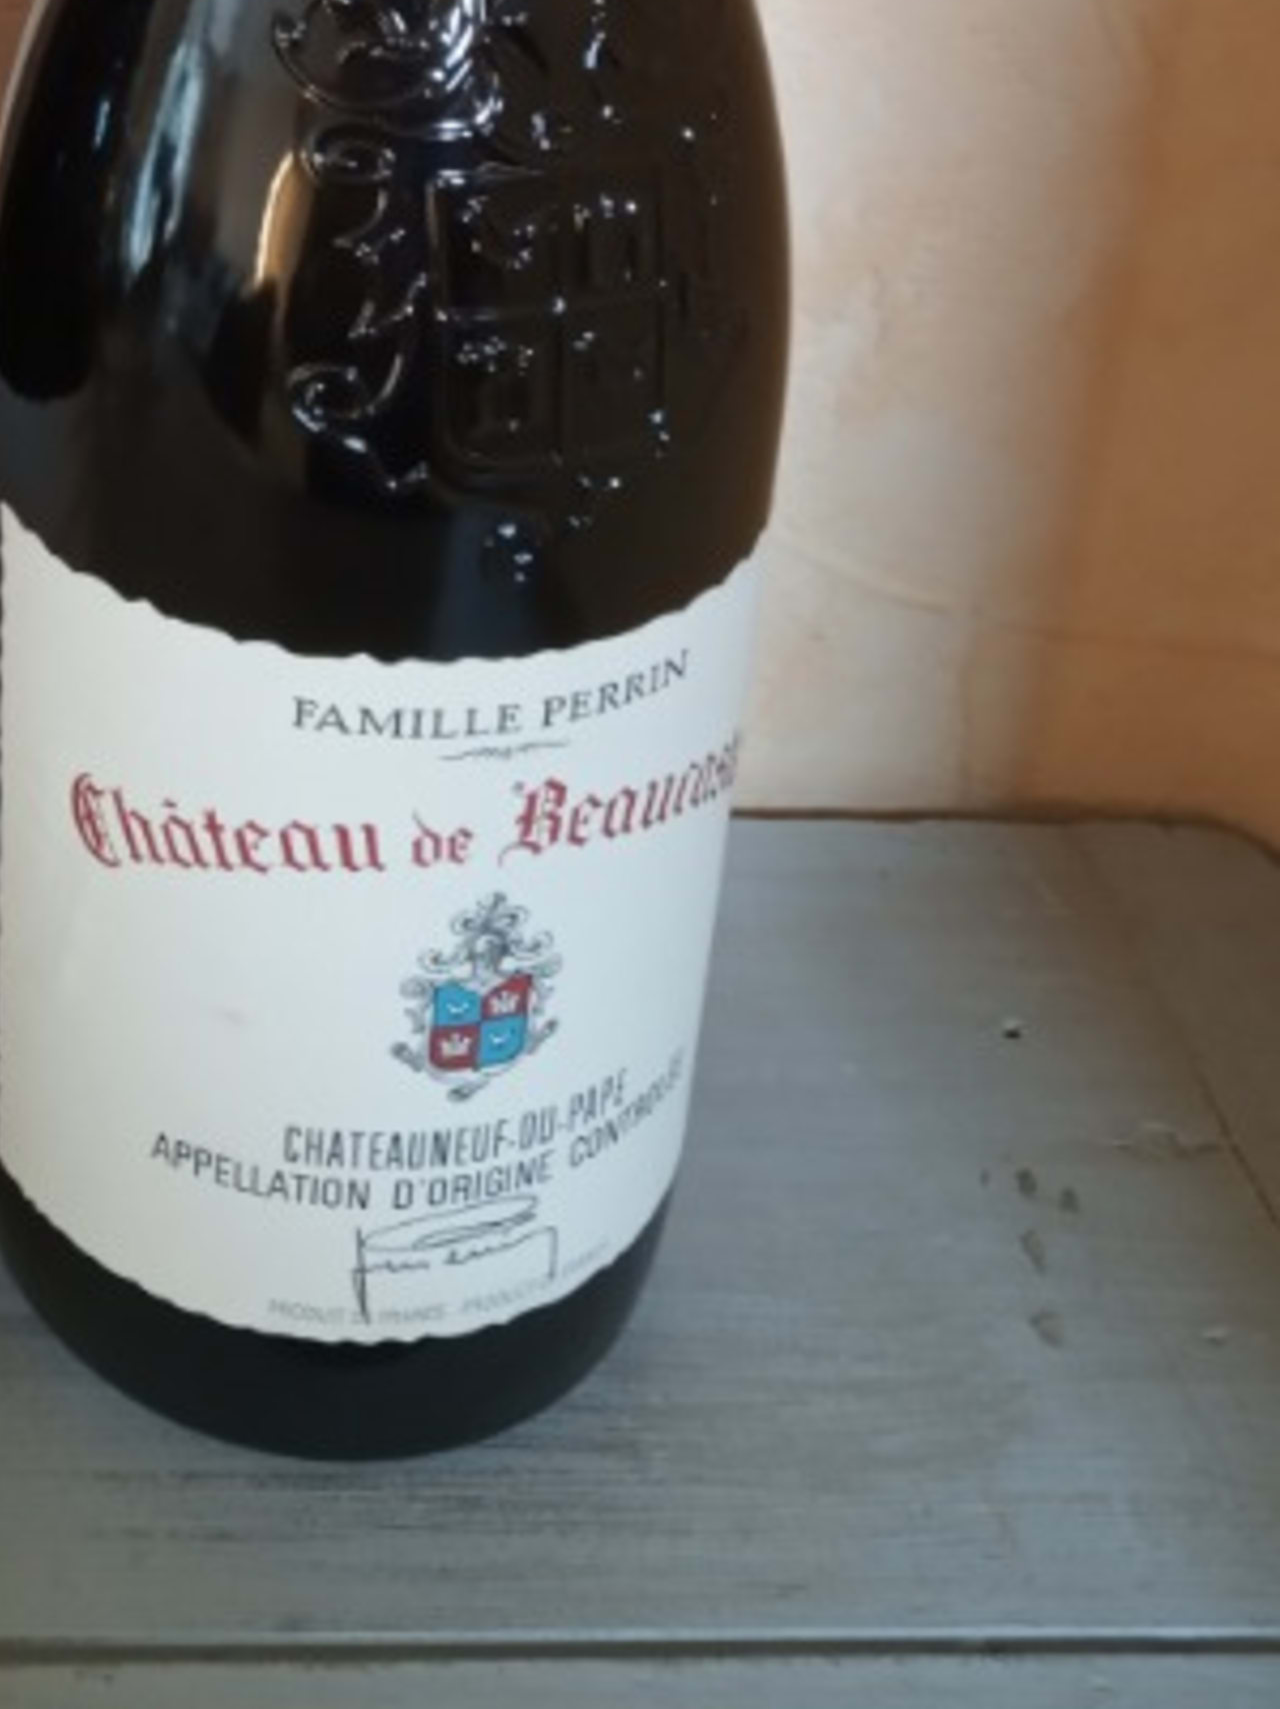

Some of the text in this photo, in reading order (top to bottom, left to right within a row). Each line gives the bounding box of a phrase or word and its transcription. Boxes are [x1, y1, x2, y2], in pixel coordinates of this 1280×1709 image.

[292, 648, 692, 740] FAMILLE PERRIN
[70, 771, 387, 874] Château
[410, 810, 475, 869] de
[150, 1131, 371, 1212] APPELLATION
[393, 1154, 553, 1211] D'ORIGINE
